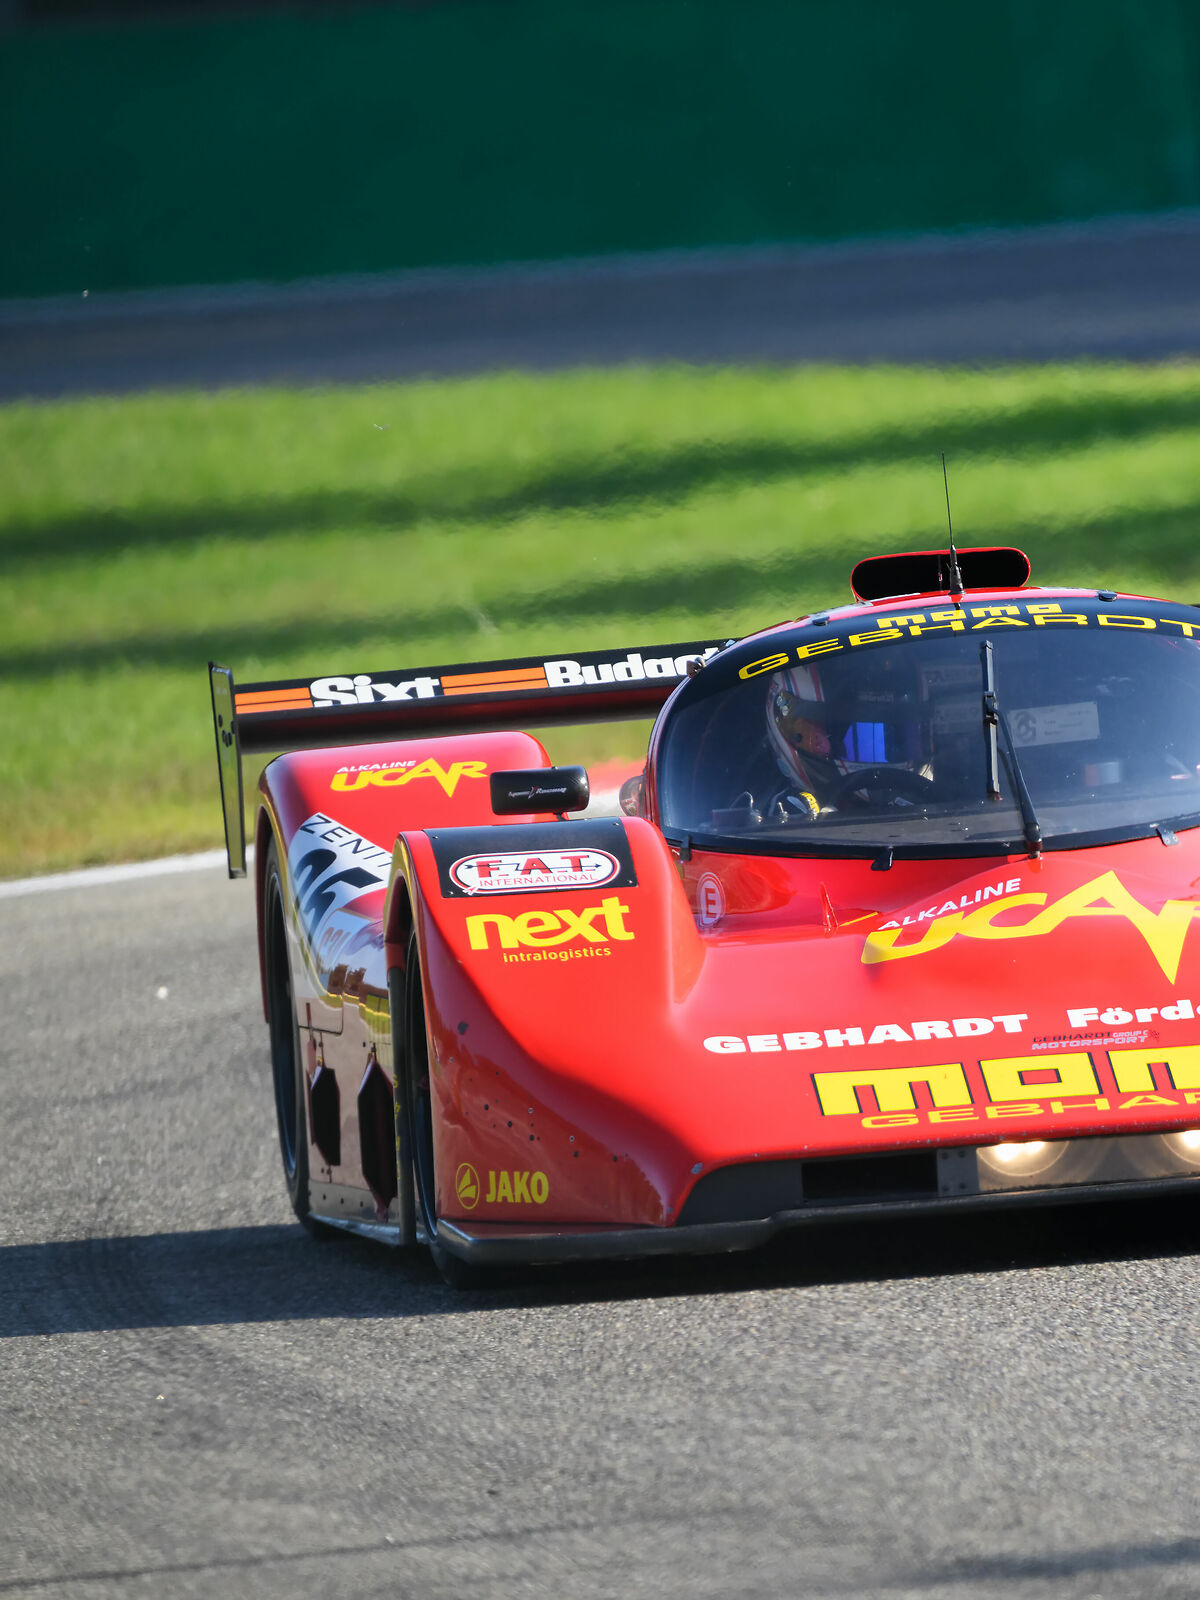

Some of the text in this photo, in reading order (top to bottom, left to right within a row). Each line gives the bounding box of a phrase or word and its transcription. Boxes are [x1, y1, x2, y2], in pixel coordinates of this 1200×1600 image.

[310, 675, 440, 708] Sixt
[330, 757, 488, 798] UCAR
[337, 760, 417, 773] ALKALINE
[475, 854, 597, 879] F.A.T.
[479, 874, 598, 887] INTERNATIONAL
[878, 877, 1022, 931] ALKALINE
[465, 896, 635, 950] next
[503, 946, 612, 963] intralogistics
[703, 1013, 1028, 1054] GEBHARDT
[1031, 1036, 1148, 1050] MOTORSPORT
[1033, 1031, 1111, 1043] GEBHARDT
[1112, 1030, 1141, 1038] GROUP
[485, 1170, 549, 1204] JAKO
